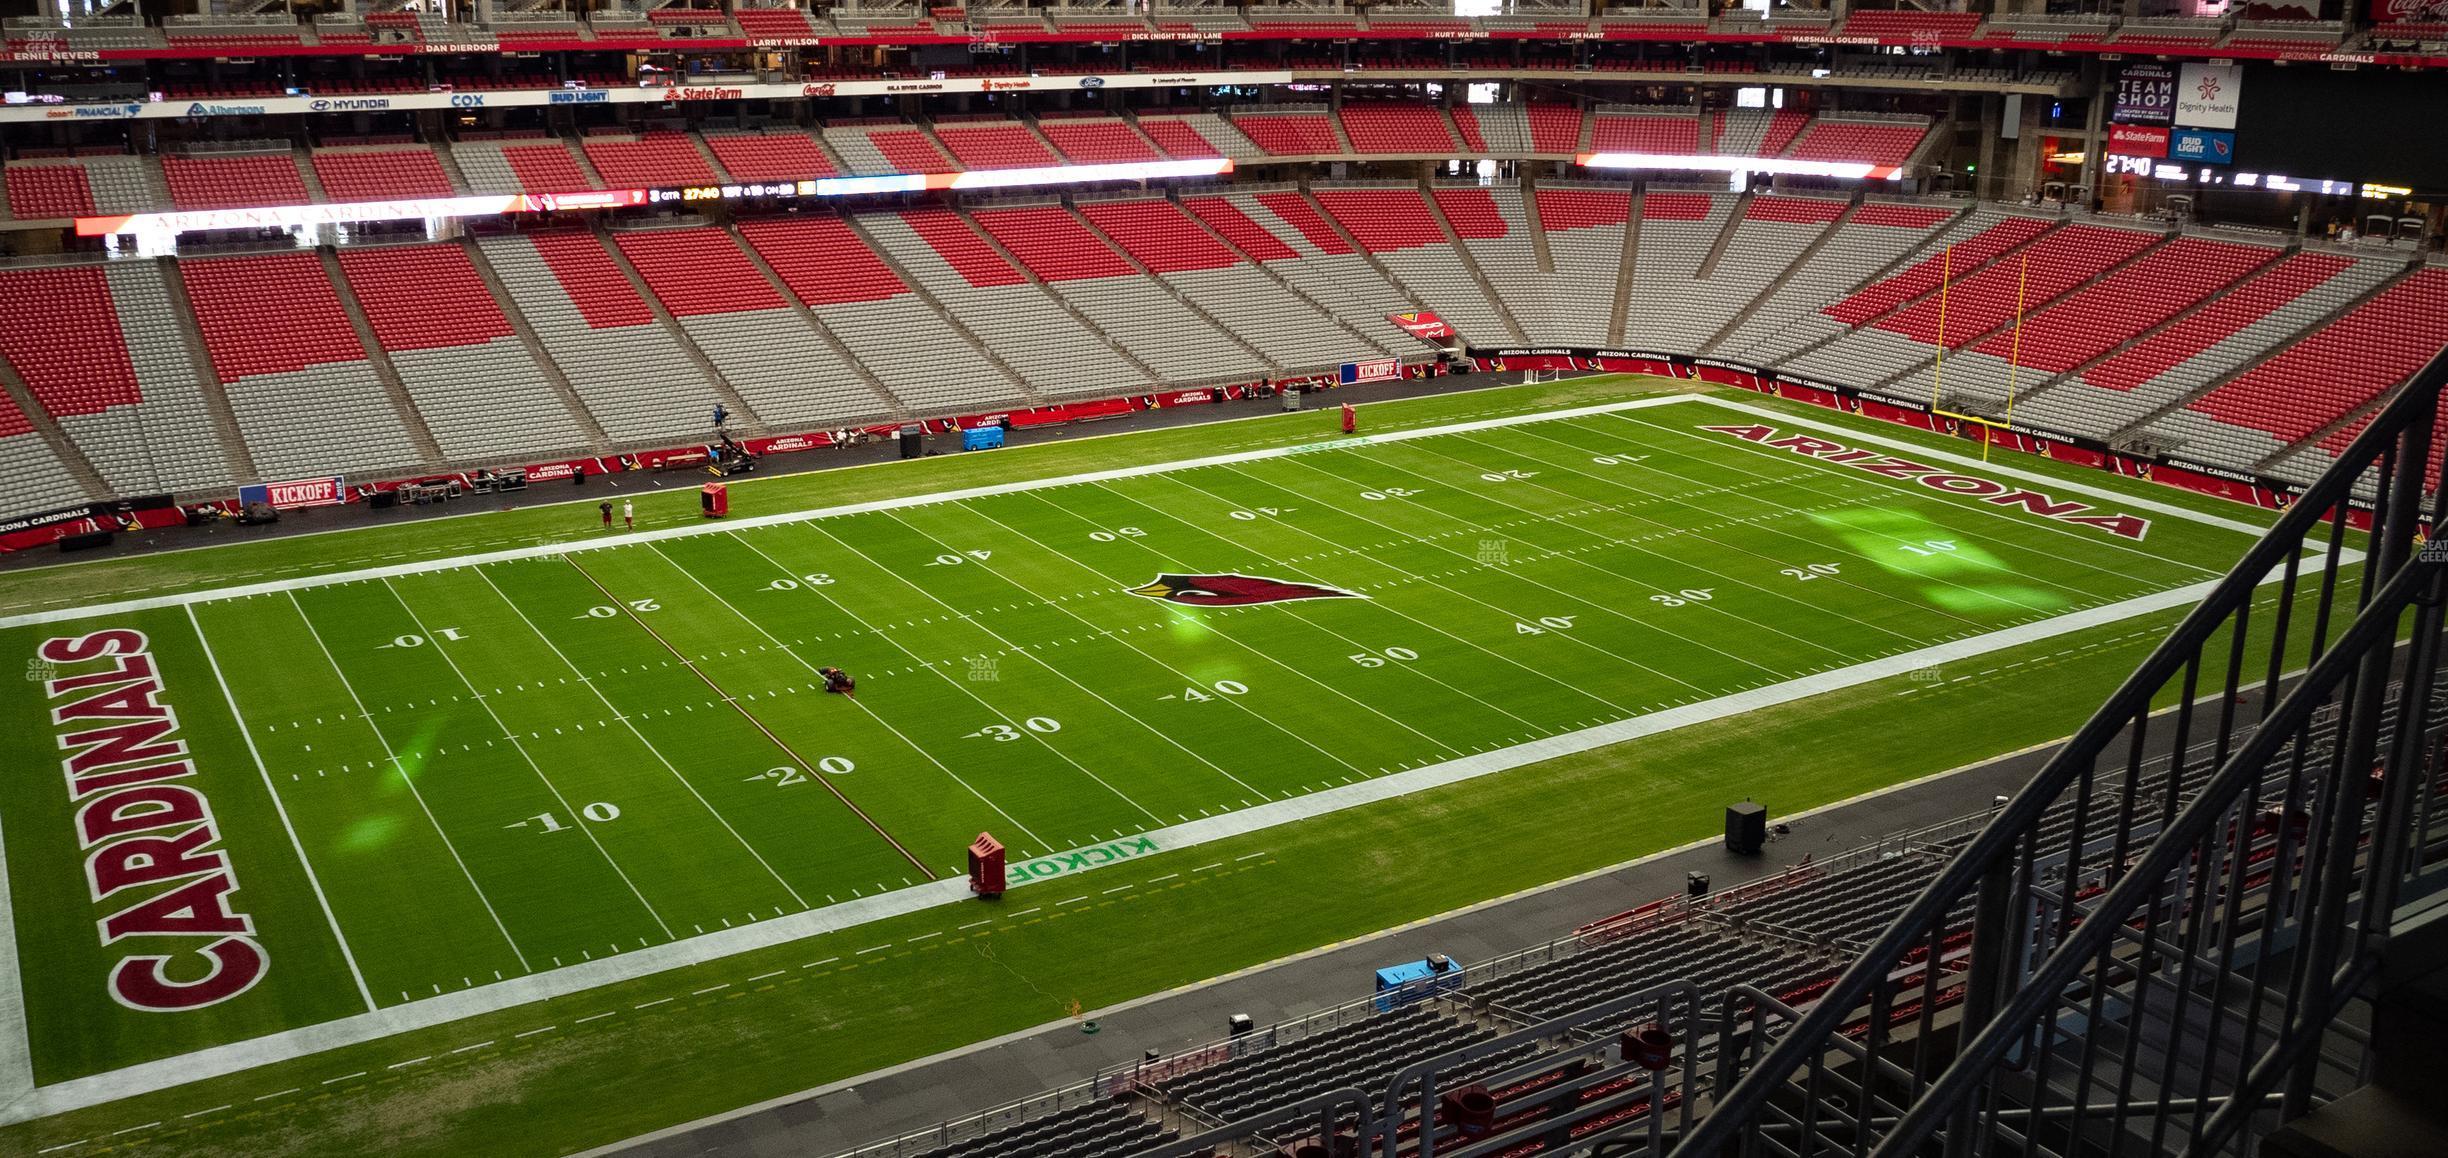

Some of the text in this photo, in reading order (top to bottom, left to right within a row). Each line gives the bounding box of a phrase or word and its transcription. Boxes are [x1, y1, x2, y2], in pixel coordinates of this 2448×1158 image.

[753, 39, 782, 47] LARRY
[784, 38, 819, 46] WILSON
[1792, 35, 1834, 43] MARSHALL
[426, 45, 448, 53] DAN
[450, 44, 500, 53] DIERDORF
[53, 52, 99, 60] NEVERS
[2279, 52, 2375, 63] ARIZONA CARDINALS
[2121, 70, 2172, 78] CARDINALS
[2119, 80, 2172, 94] TEAM
[451, 94, 484, 107] COX
[551, 91, 607, 102] BUD LIGHT
[2118, 93, 2170, 107] SHOP
[209, 105, 266, 116] Albertsons
[333, 98, 389, 110] HYUNDAI
[2179, 102, 2234, 113] Dignity Health
[75, 107, 121, 117] FINANCIAL
[2182, 137, 2201, 145] BUD
[2177, 144, 2204, 153] LIGHT
[1631, 353, 1670, 361] CARDINALS
[1358, 363, 1394, 379] KICKOFF
[1694, 359, 1757, 374] ARIZONA CARDINALS
[1776, 374, 1837, 392] ARIZONA CARDINALS
[1174, 395, 1211, 404] CARDINALS
[1858, 392, 1924, 411] ARIZONA CARDINALS
[776, 437, 804, 445] ARIZONA
[2032, 428, 2075, 444] CARDINALS
[767, 440, 813, 451] CARDINALS
[529, 469, 574, 479] CARDINAL
[539, 464, 570, 472] ARIZONA
[2168, 459, 2256, 483] ARIZONA CARDINALS
[1695, 424, 2152, 541] ARIZONA
[271, 482, 331, 504] KICKOFF
[31, 508, 90, 525] CARDINALS
[1089, 526, 1148, 543] 50
[1900, 539, 1955, 557] 10
[1781, 563, 1836, 582] 20
[1650, 588, 1713, 608] 30
[1514, 615, 1574, 638] 40
[1349, 646, 1419, 669] 50
[1180, 679, 1249, 703] 40
[980, 715, 1062, 744] 30
[764, 755, 857, 788] 20
[36, 628, 271, 1012] CARDINALS
[526, 801, 621, 835] 10
[1006, 836, 1160, 886] KICKOF
